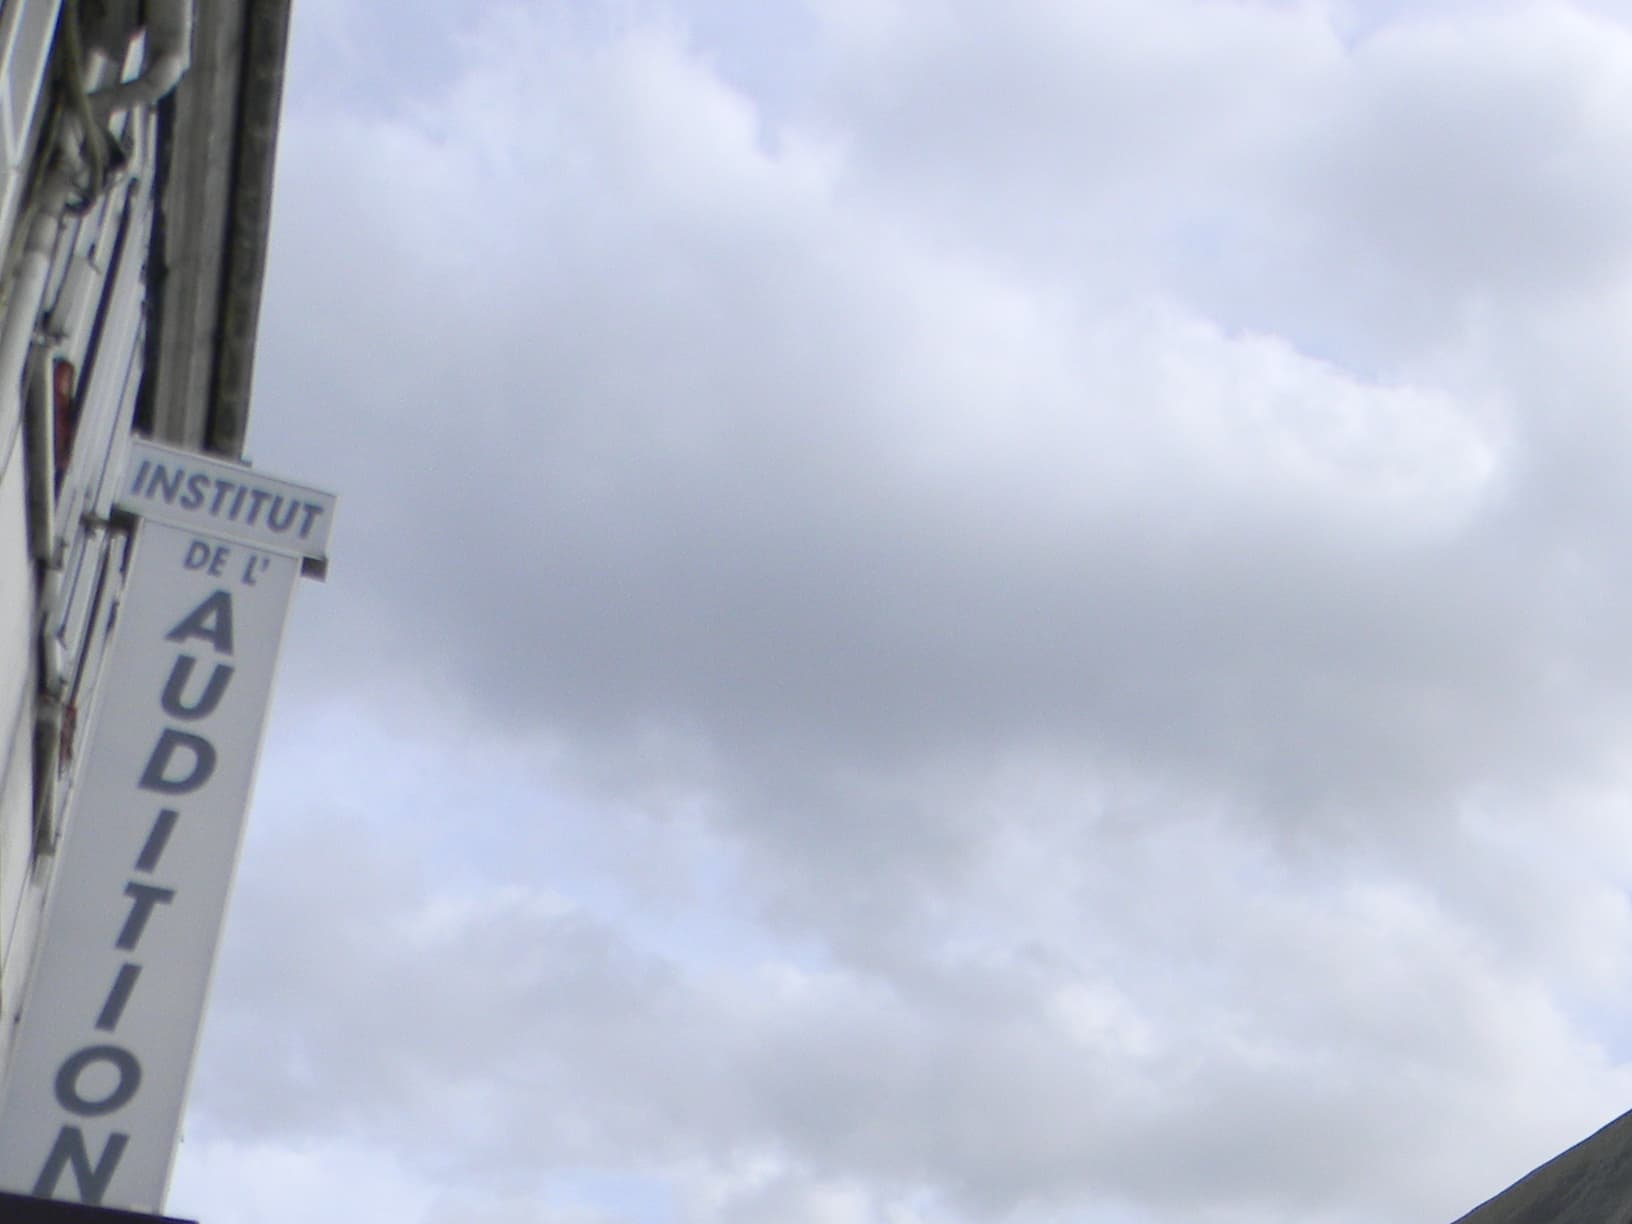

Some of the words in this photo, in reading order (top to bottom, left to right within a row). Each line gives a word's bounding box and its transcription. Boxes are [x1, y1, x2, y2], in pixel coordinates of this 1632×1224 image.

[131, 458, 324, 541] INSTITUT
[183, 540, 228, 578] DE
[242, 557, 270, 587] L'
[31, 589, 236, 1206] AUDITION
